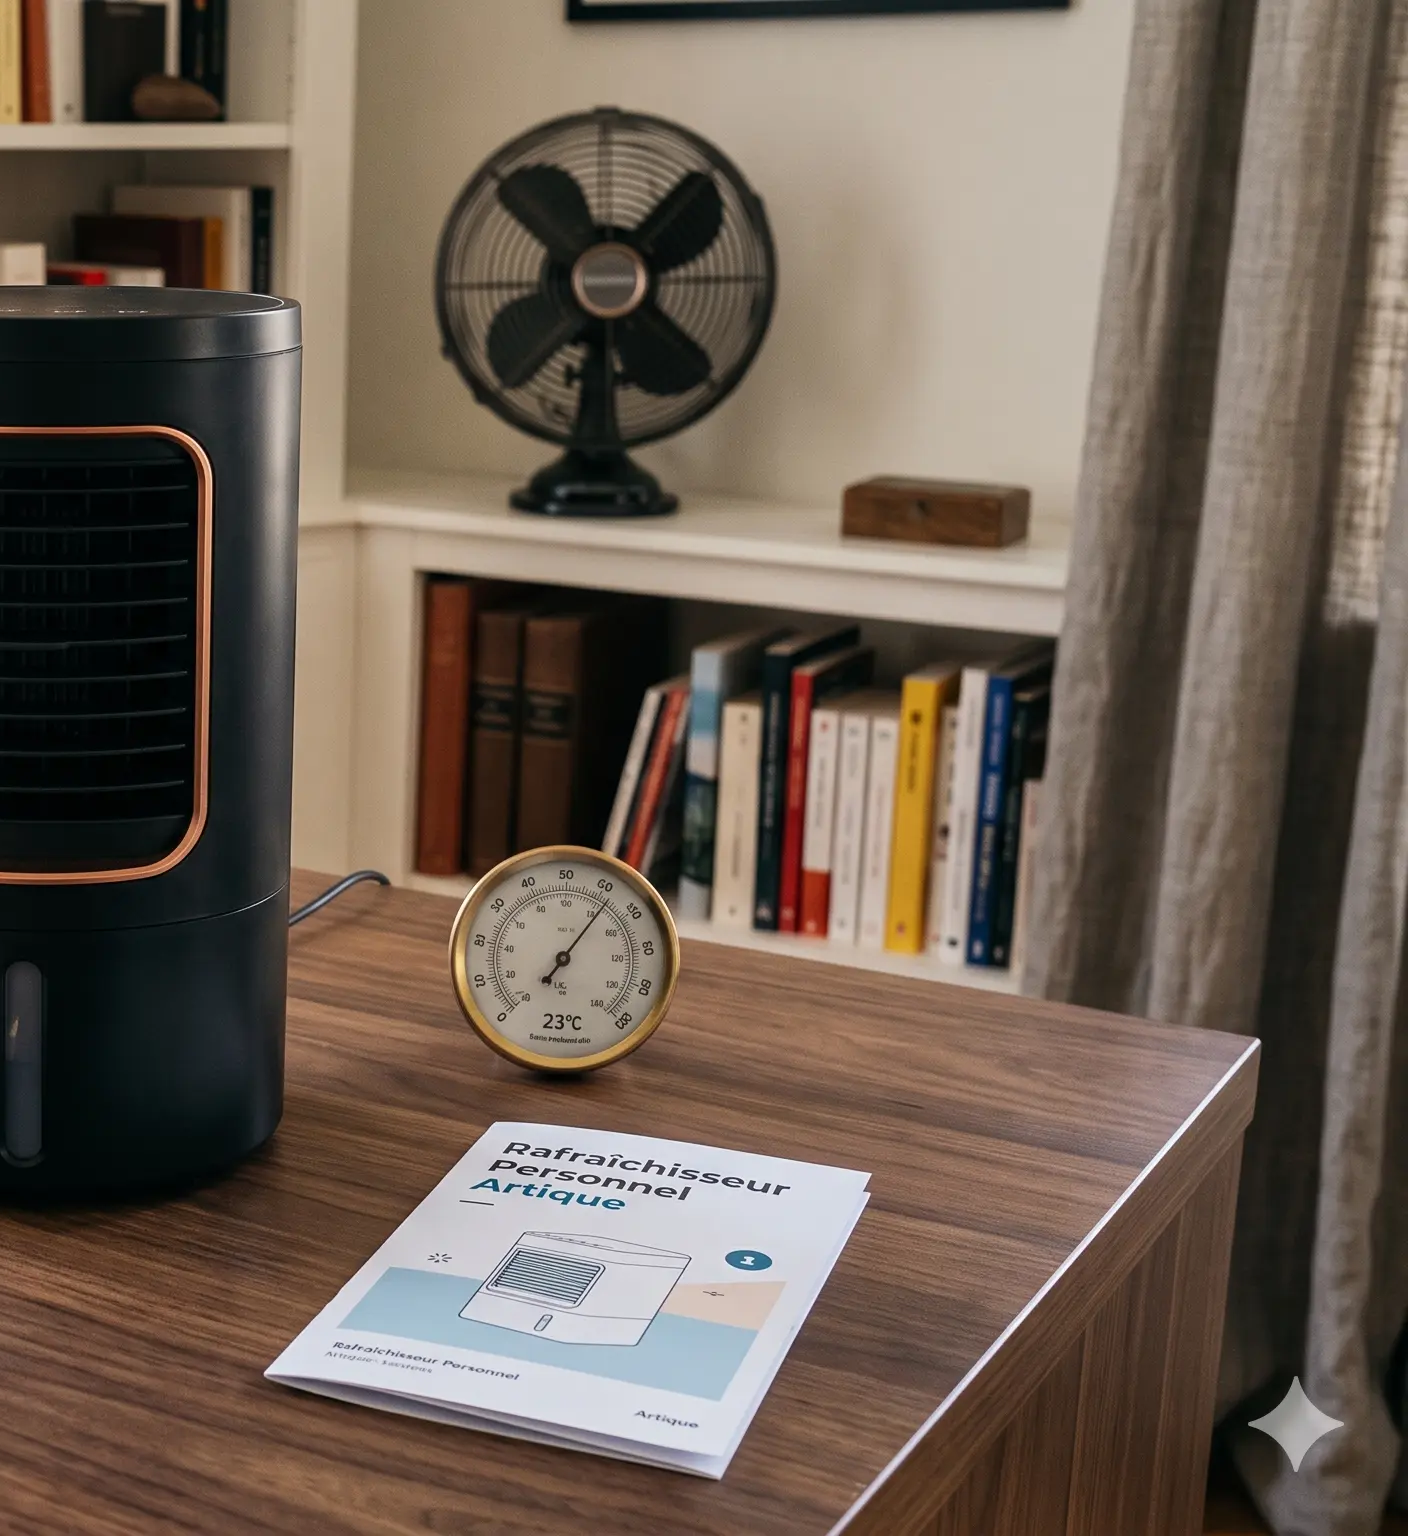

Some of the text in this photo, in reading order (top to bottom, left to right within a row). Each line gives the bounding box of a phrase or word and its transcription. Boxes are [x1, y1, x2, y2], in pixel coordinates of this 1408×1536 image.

[521, 876, 536, 888] 40
[559, 869, 574, 880] 50
[597, 879, 614, 892] 60
[503, 945, 514, 953] 40
[542, 1013, 582, 1031] 23°C
[502, 1141, 791, 1196] Rafraîchisseur
[488, 1158, 692, 1201] Personnel
[469, 1177, 626, 1211] Artique
[441, 1359, 520, 1381] Personnel
